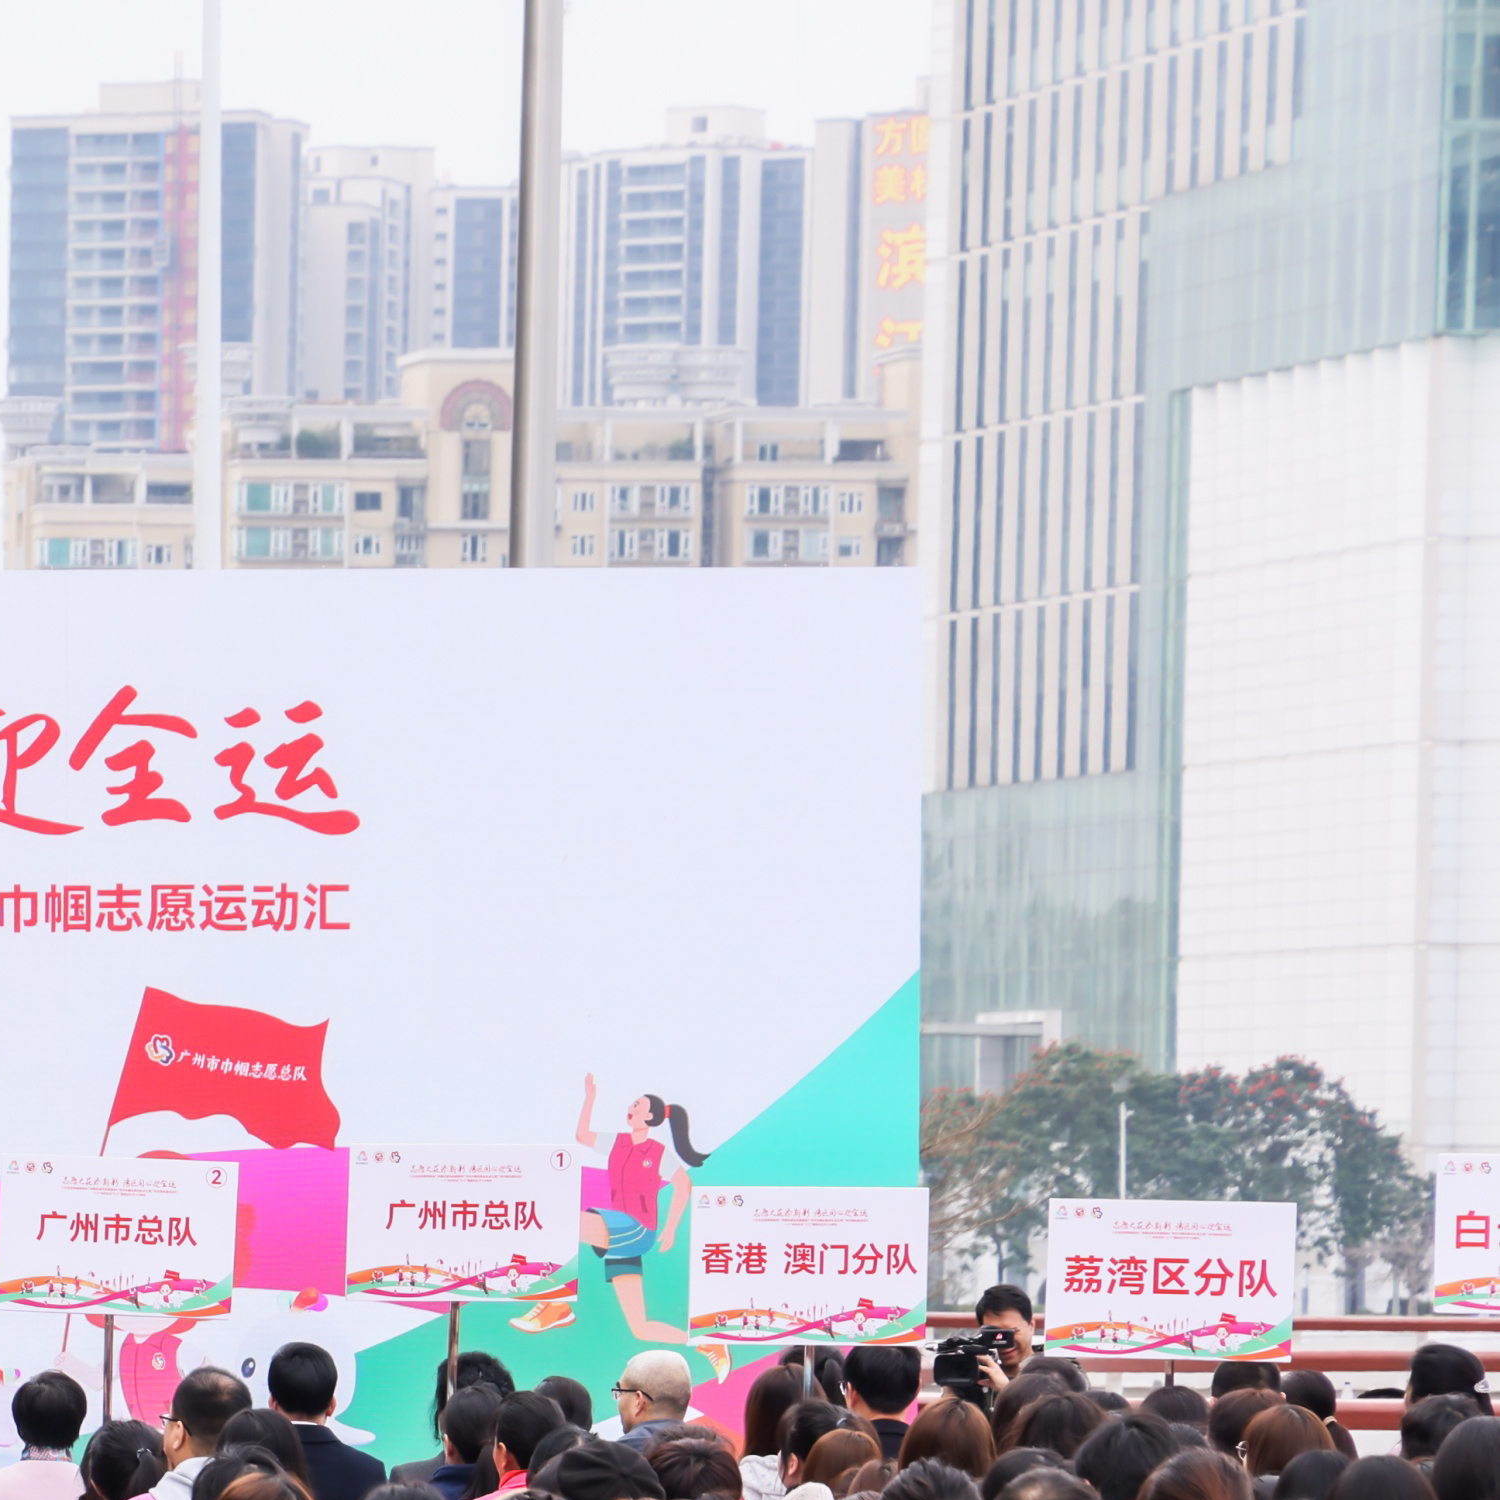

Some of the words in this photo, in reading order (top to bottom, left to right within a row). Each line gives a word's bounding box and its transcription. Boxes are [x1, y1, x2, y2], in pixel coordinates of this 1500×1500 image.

[177, 1049, 307, 1081] 广州市巾帼志愿总队
[36, 1211, 197, 1247] 广州市总队
[387, 1199, 543, 1231] 广州市总队
[1456, 1210, 1500, 1249] 白
[701, 1242, 768, 1275] 香港
[783, 1242, 918, 1275] 澳门分队
[1064, 1255, 1278, 1298] 荔湾区分队
